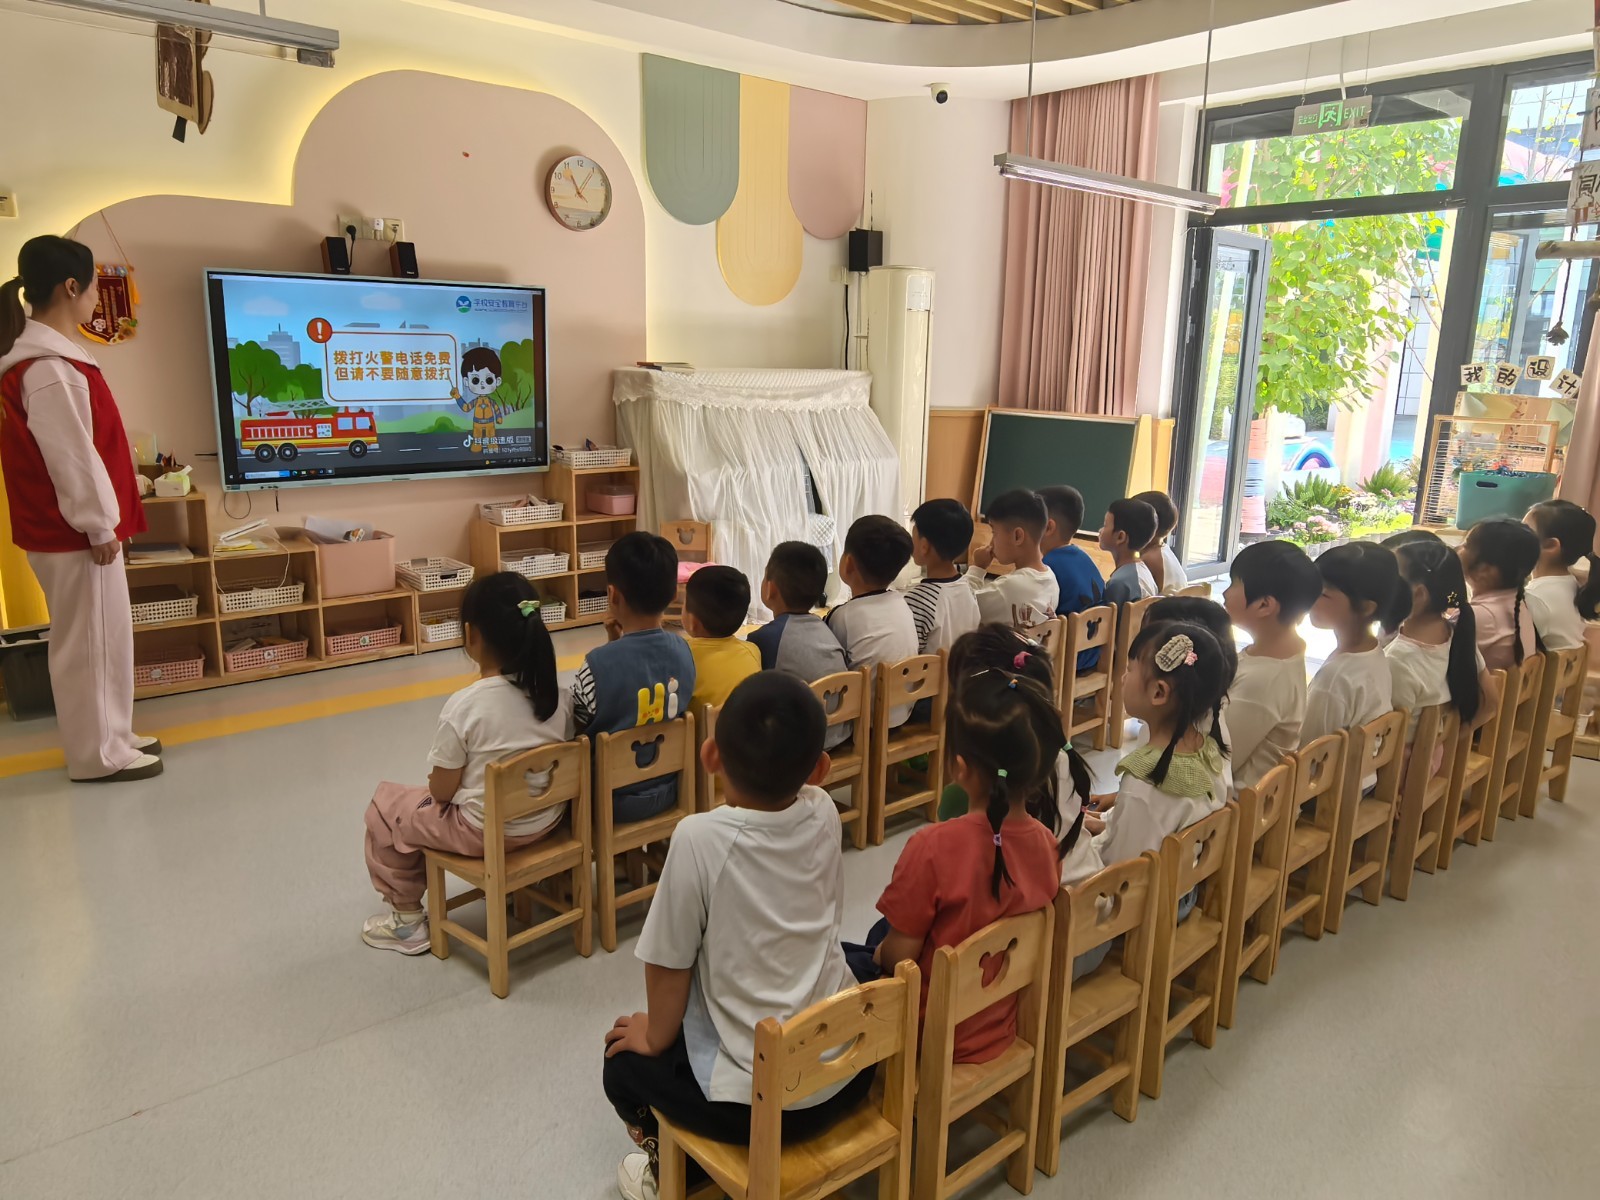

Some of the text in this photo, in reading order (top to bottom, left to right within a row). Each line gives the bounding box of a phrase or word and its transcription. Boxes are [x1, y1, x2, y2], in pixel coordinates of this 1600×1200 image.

[1343, 105, 1366, 119] EXIT
[554, 172, 562, 181] 10
[333, 350, 451, 365] 拨打火警电话免费
[334, 367, 451, 381] 但请不要随意拨打
[1464, 359, 1577, 394] 我的设计
[635, 677, 679, 727] Hi
